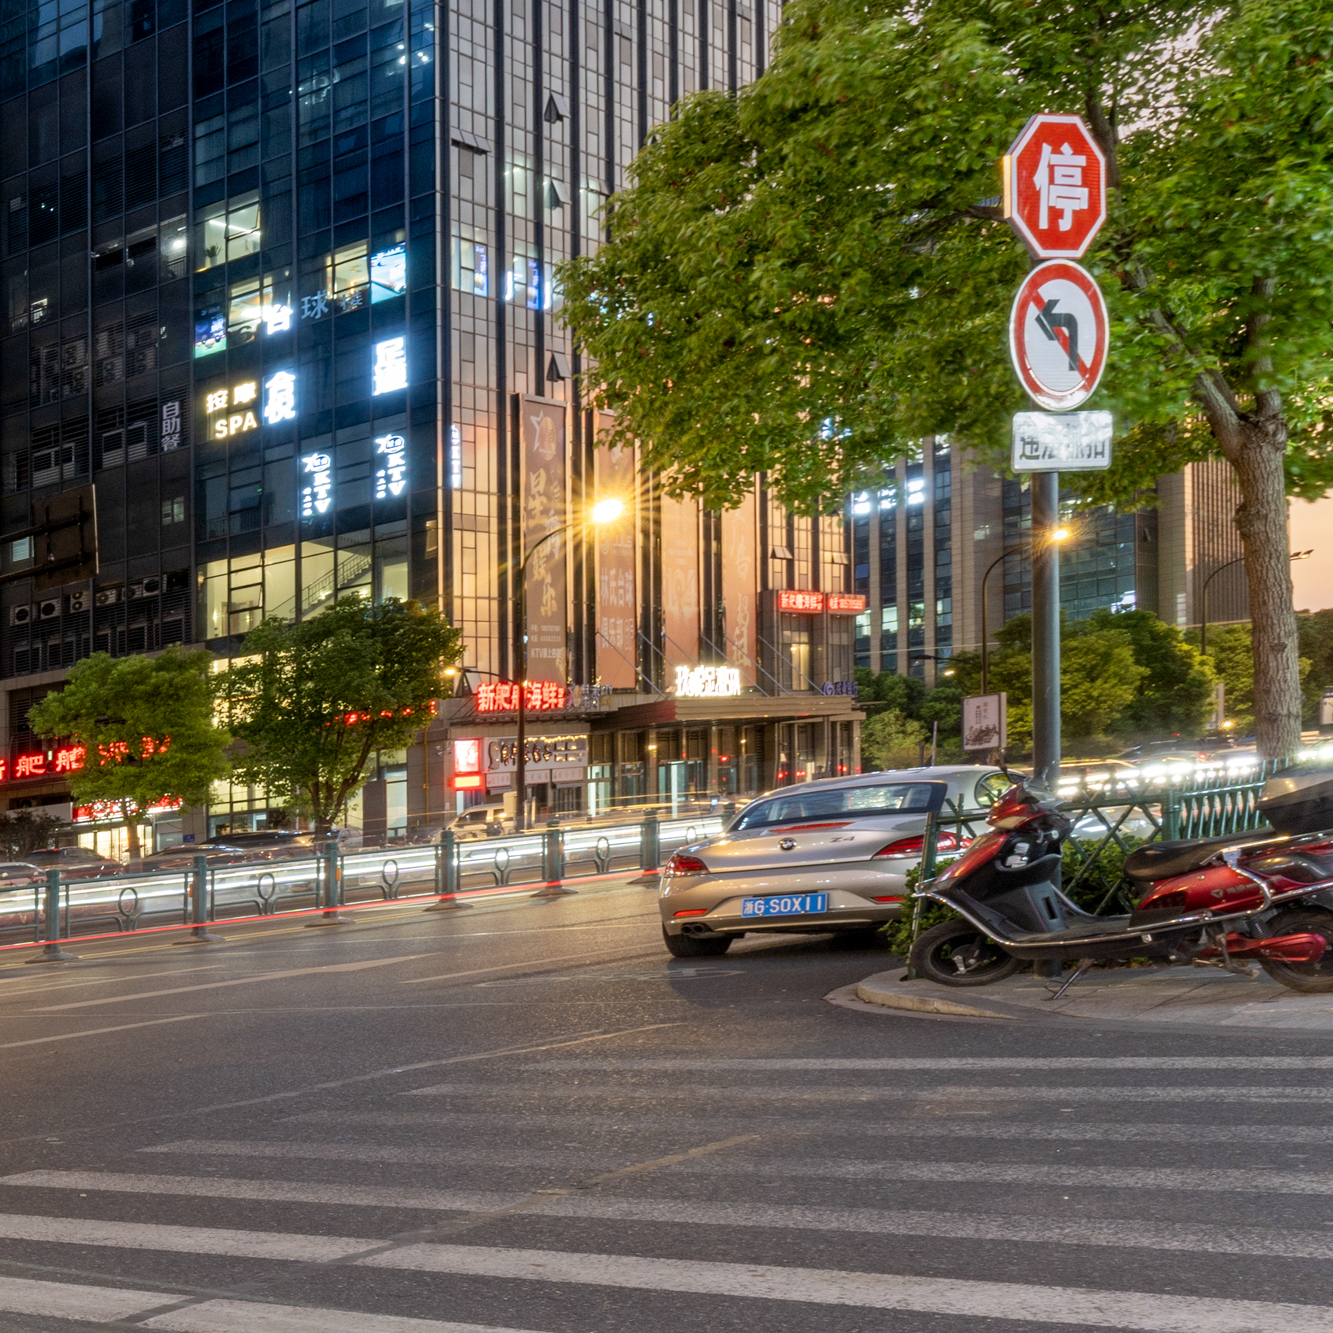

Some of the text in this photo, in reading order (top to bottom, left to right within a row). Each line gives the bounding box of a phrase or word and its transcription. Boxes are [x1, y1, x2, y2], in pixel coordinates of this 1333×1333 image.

[1033, 142, 1089, 232] 停
[206, 381, 257, 414] 按摩
[161, 400, 181, 452] 自助餐
[215, 411, 258, 438] SPA
[313, 470, 331, 513] KTV
[387, 451, 406, 496] KTV
[830, 835, 856, 843] Z4
